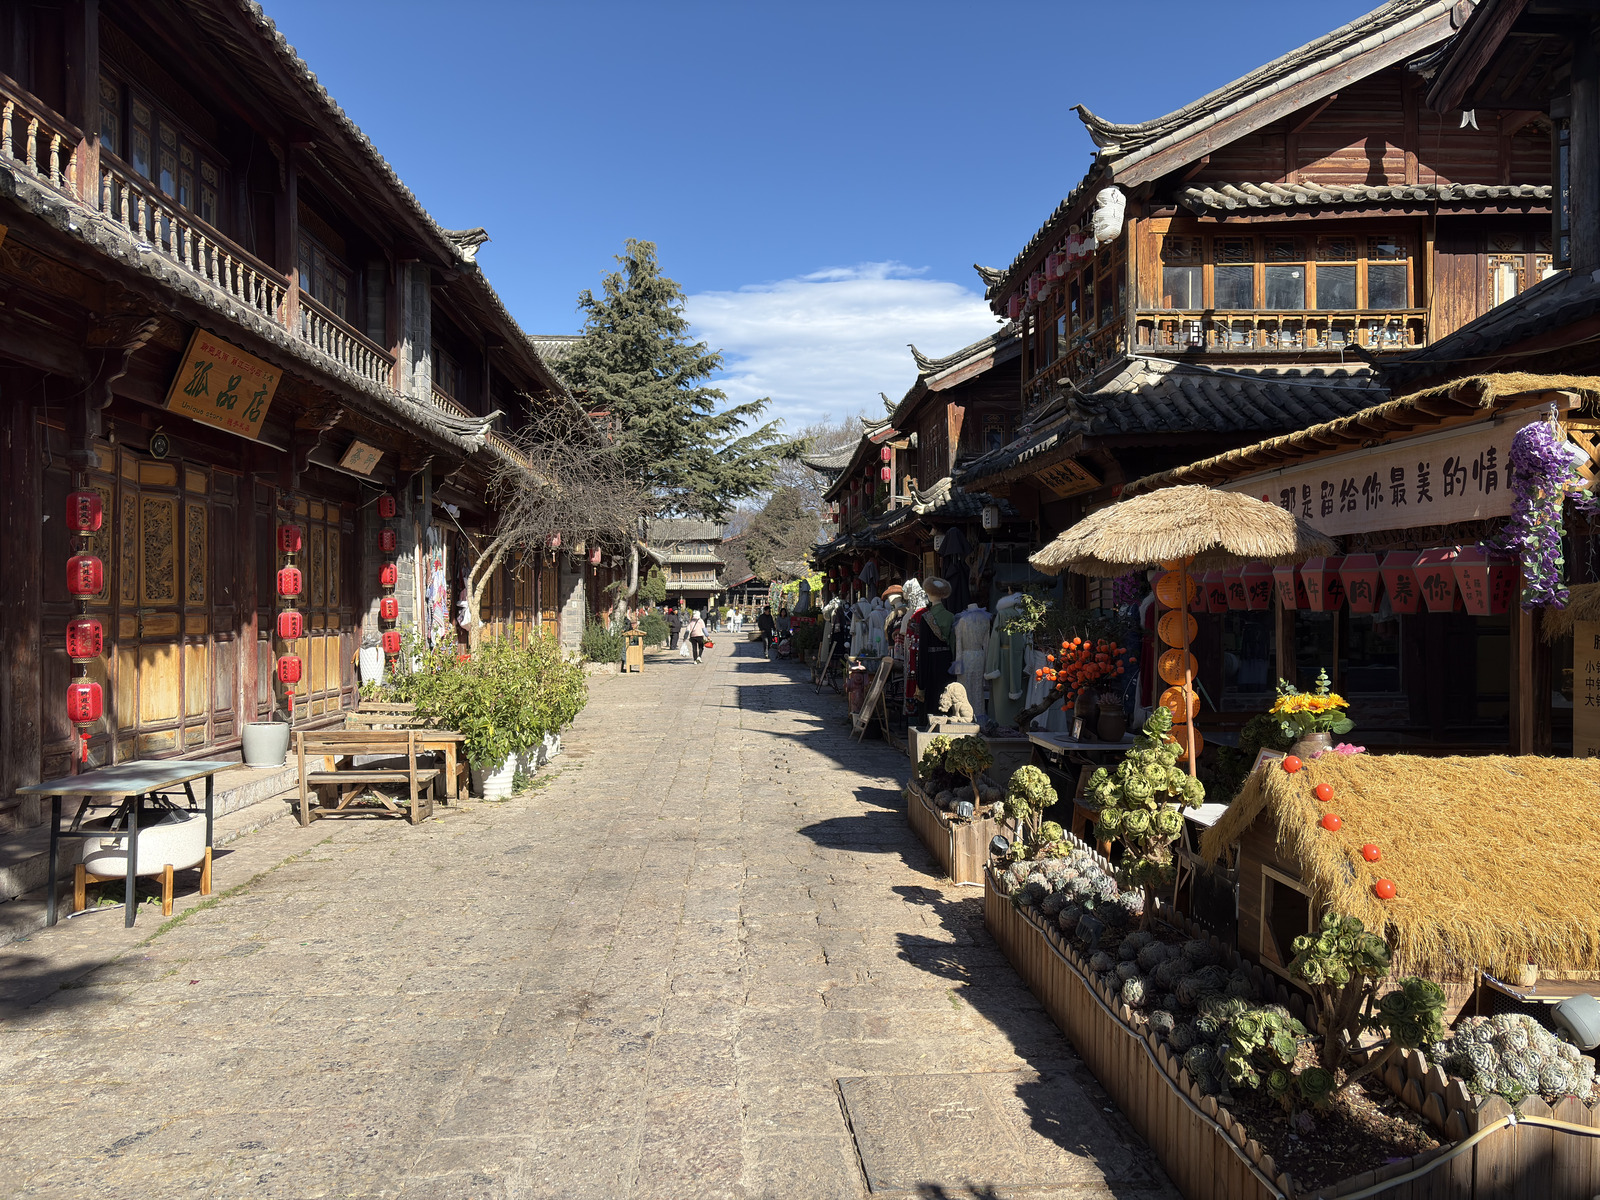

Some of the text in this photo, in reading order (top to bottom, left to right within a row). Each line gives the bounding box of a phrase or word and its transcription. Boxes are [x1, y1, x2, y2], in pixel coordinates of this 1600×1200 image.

[181, 401, 223, 422] Unique store
[1280, 445, 1516, 520] 那是留给你最美的情
[1250, 581, 1270, 602] 烤
[1349, 579, 1372, 604] 肉
[1393, 574, 1414, 605] 养
[1423, 573, 1451, 601] 你
